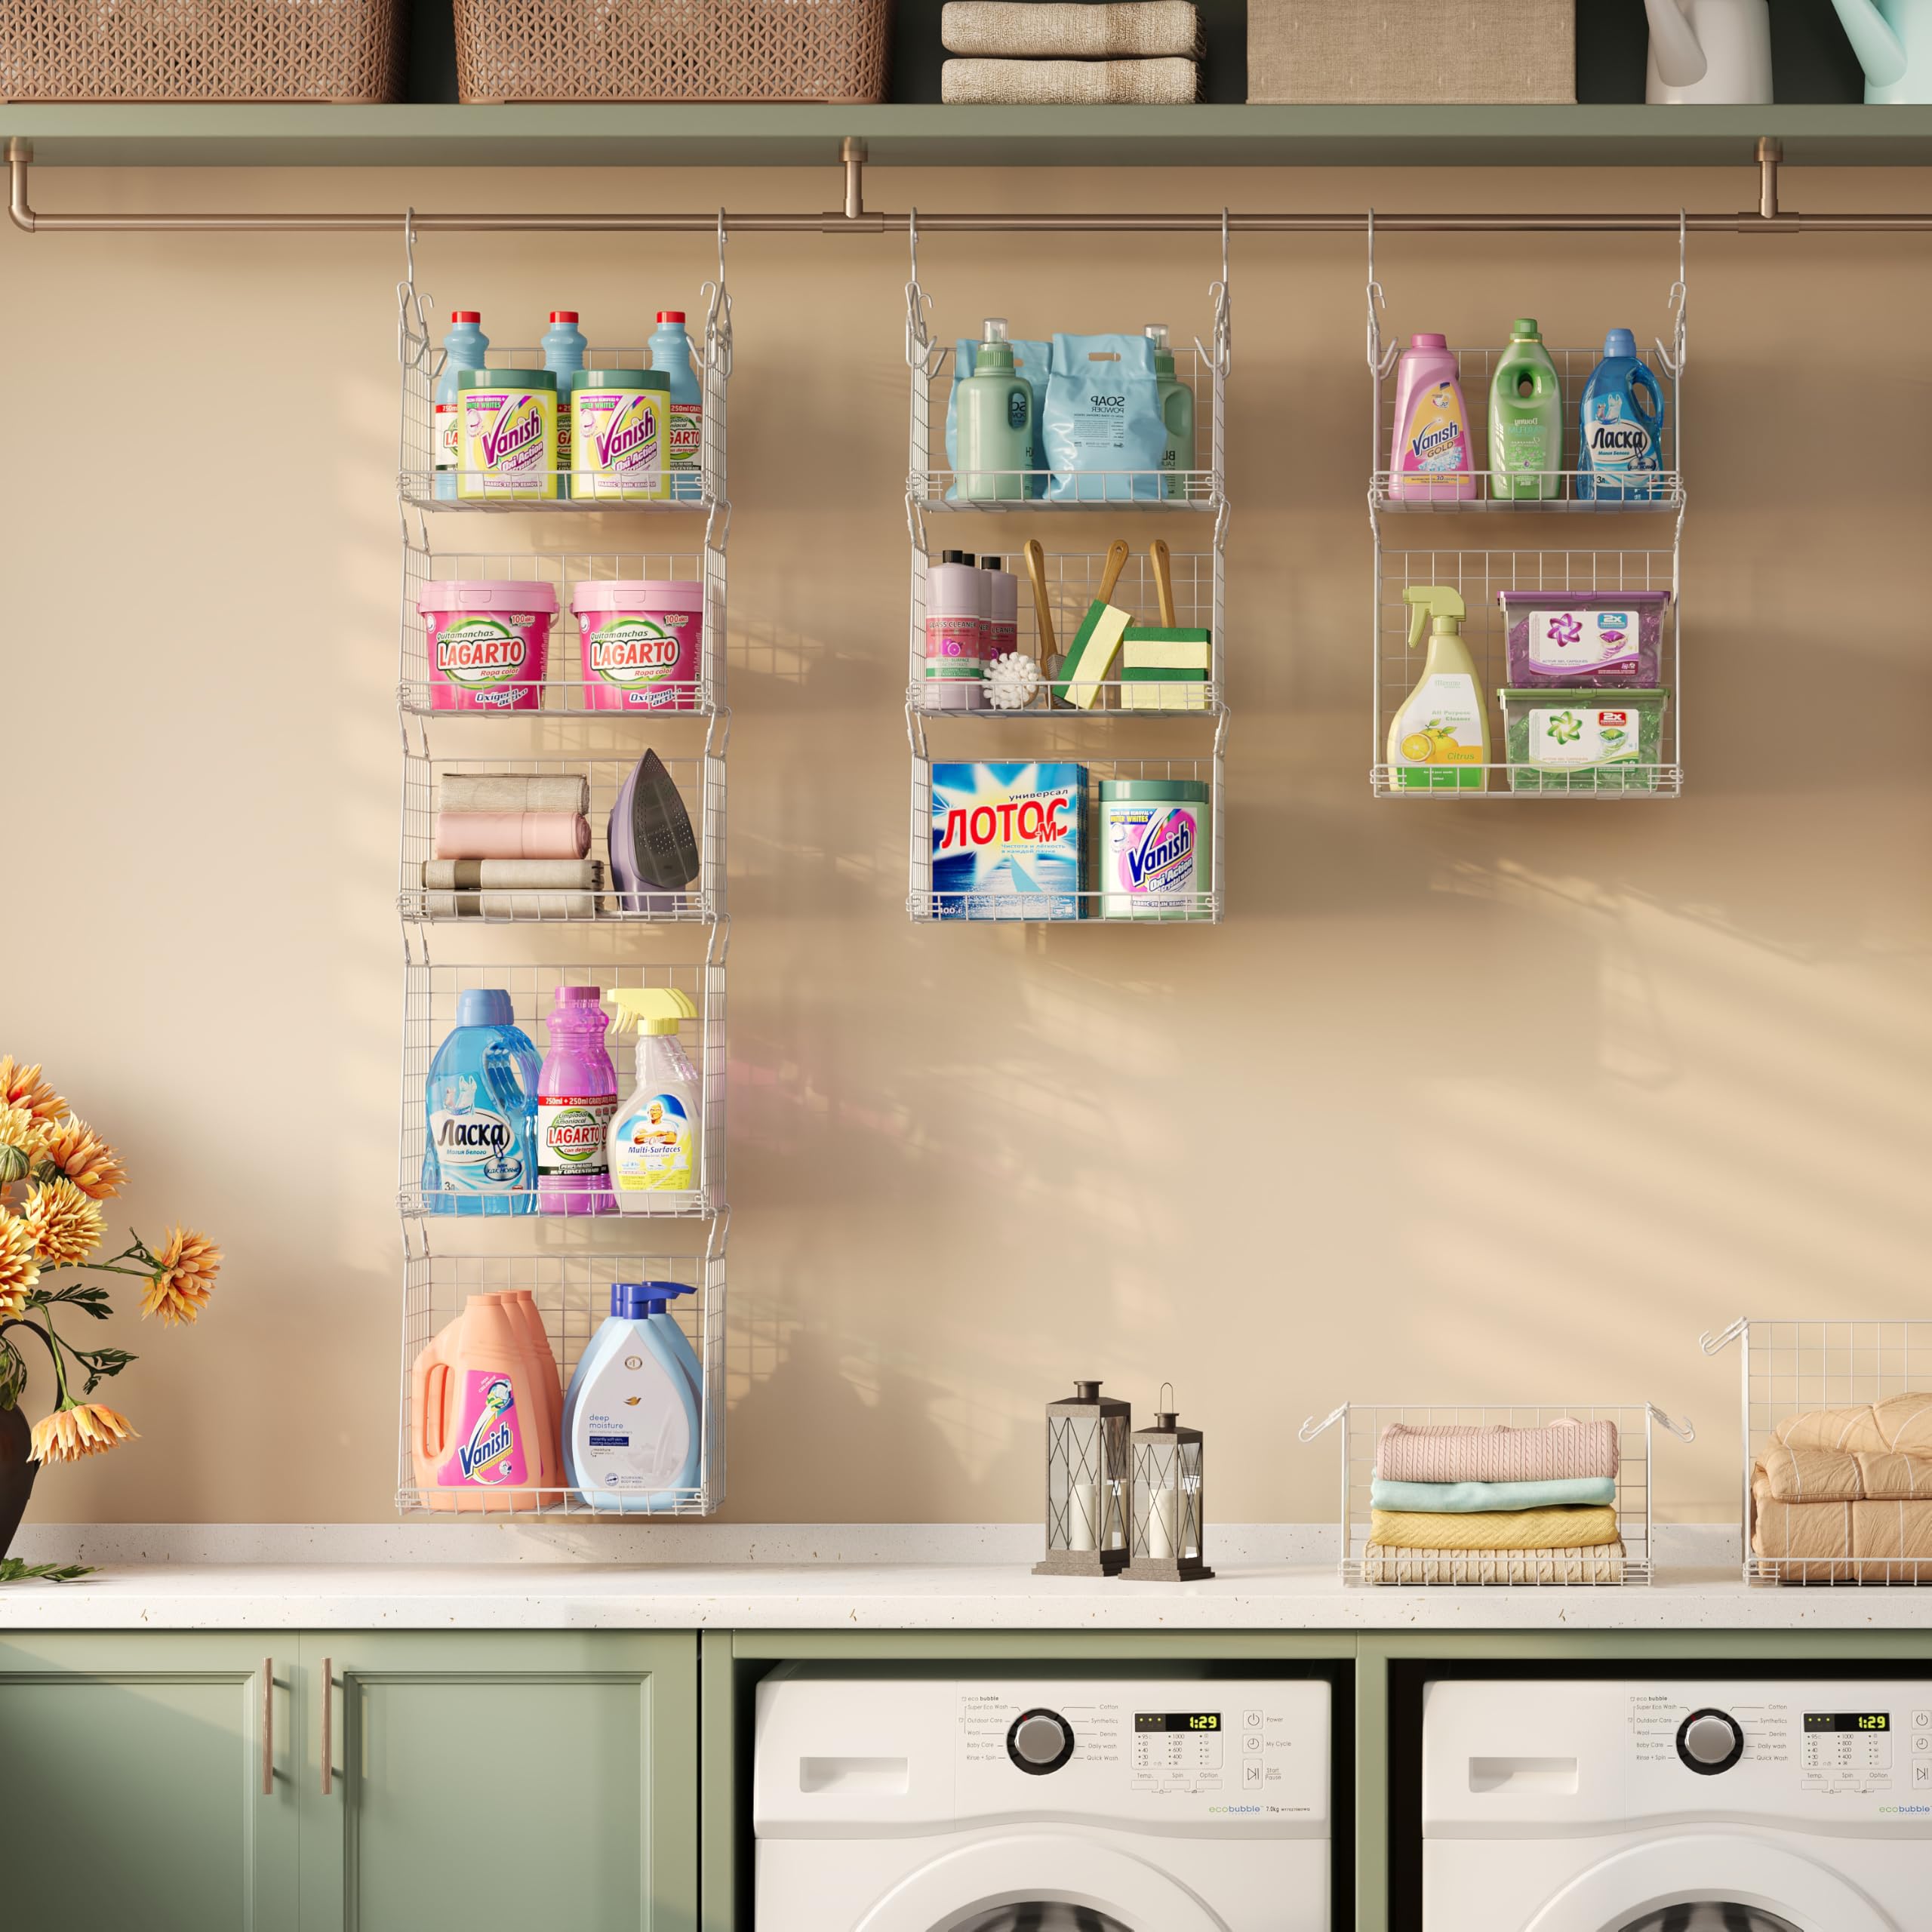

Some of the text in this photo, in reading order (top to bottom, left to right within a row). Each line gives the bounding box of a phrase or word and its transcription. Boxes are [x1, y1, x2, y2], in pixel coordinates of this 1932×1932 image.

[482, 408, 540, 466] Vanish
[596, 409, 654, 466] Vanish
[1412, 420, 1458, 457] Vanish
[1591, 427, 1643, 449] Ласка
[518, 441, 543, 464] Action
[632, 441, 657, 464] Action
[1427, 441, 1454, 458] GOLD
[512, 615, 525, 624] 100
[666, 615, 678, 624] 100
[1604, 614, 1622, 623] 2x
[437, 629, 494, 641] Quitamanchas
[591, 629, 648, 641] Quitamanchas
[439, 641, 522, 666] LAGARTO
[593, 641, 675, 666] LAGARTO
[1604, 712, 1622, 721] 2x
[1447, 752, 1475, 761] Citrus
[1009, 789, 1069, 801] универсал
[941, 798, 1068, 849] ЛОТОС
[1128, 820, 1190, 883] Vanish
[1149, 857, 1192, 891] Oxi Action
[438, 1118, 504, 1146] Ласка
[549, 1128, 600, 1144] LAGARTO
[628, 1146, 681, 1154] Multi-Surfaces
[589, 1414, 610, 1423] deep
[589, 1421, 623, 1429] moisture
[460, 1421, 509, 1475] Vanish
[1189, 1716, 1217, 1729] 1:29
[1859, 1716, 1885, 1729] 1:29
